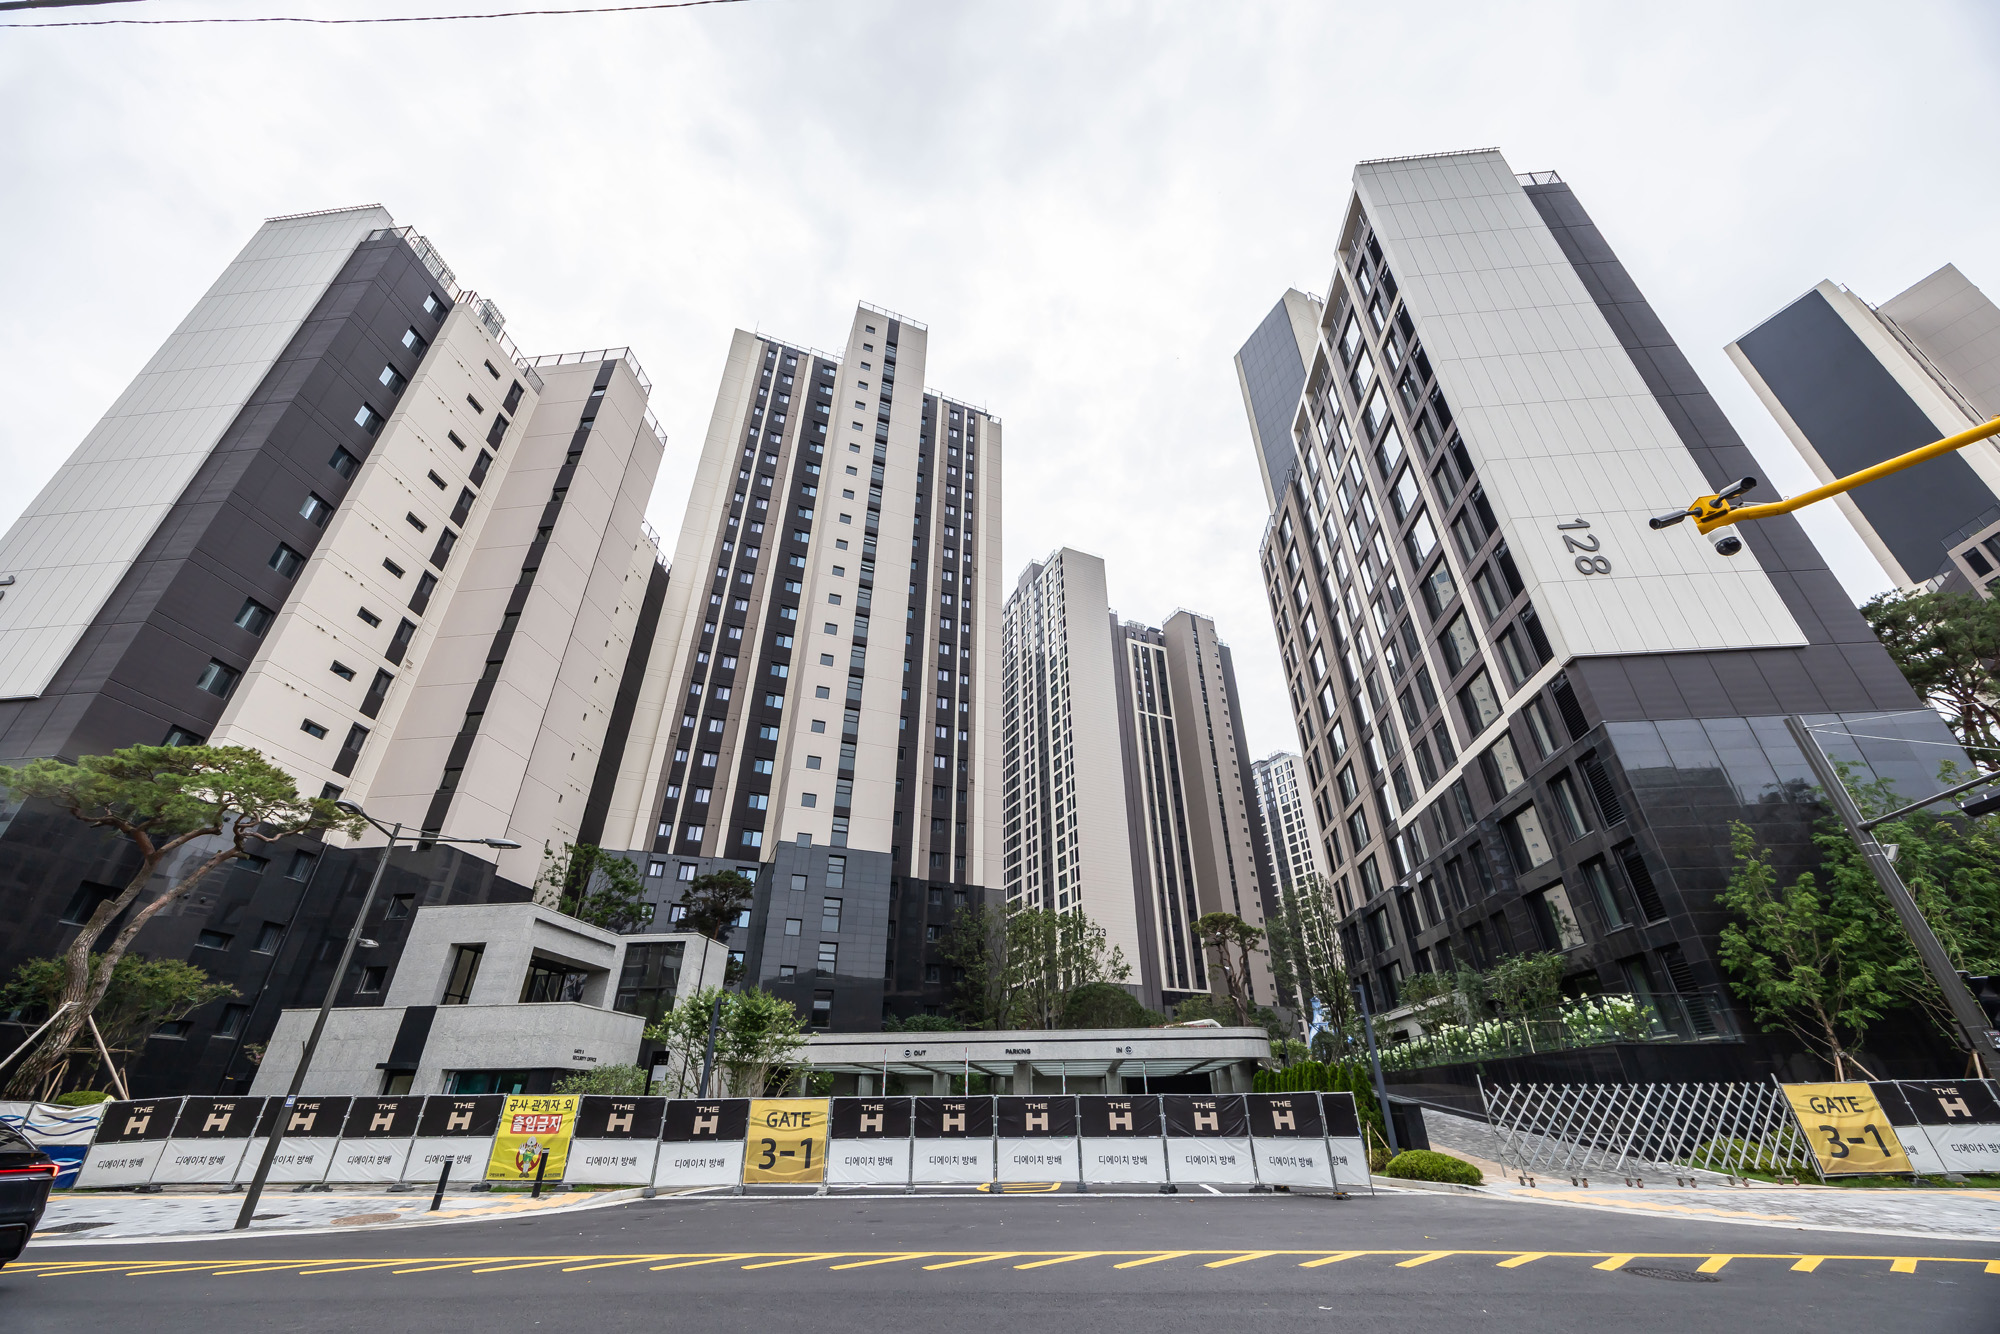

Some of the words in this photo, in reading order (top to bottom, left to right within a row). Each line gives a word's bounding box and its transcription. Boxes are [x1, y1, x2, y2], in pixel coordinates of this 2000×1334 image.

[1557, 518, 1612, 575] 128
[509, 1099, 528, 1112] 공사
[531, 1099, 561, 1112] 관계자
[564, 1099, 574, 1112] 외
[612, 1103, 636, 1111] THE
[1810, 1096, 1864, 1114] GATE
[1938, 1097, 1973, 1117] H
[123, 1115, 151, 1135] H
[202, 1113, 231, 1131] H
[287, 1112, 317, 1131] H
[369, 1112, 395, 1131] H
[446, 1112, 473, 1130] H
[512, 1114, 562, 1132] 출입금지
[606, 1113, 634, 1132] H
[693, 1115, 719, 1134] H
[767, 1112, 811, 1128] GATE
[860, 1113, 884, 1132] H
[942, 1113, 966, 1131] H
[1025, 1112, 1049, 1131] H
[1109, 1111, 1133, 1130] H
[1194, 1111, 1219, 1130] H
[1272, 1110, 1296, 1130] H
[1819, 1124, 1891, 1158] 3-1
[1950, 1143, 1988, 1154] 디에이치
[1988, 1143, 2000, 1154] 방
[97, 1159, 128, 1169] 디에이치
[129, 1157, 145, 1168] 방배
[175, 1156, 207, 1166] 디에이치
[208, 1155, 225, 1166] 방배
[273, 1154, 295, 1165] 에이치
[297, 1154, 315, 1165] 방배
[347, 1156, 376, 1165] 디에이치
[377, 1155, 393, 1165] 방배
[425, 1154, 447, 1165] 디에이
[456, 1154, 473, 1165] 방배
[585, 1156, 618, 1167] 디에이치
[621, 1156, 637, 1167] 방배
[758, 1138, 813, 1170] 3-1
[844, 1156, 875, 1167] 디에이치
[877, 1156, 893, 1167] 방배
[929, 1156, 959, 1166] 디에이치
[961, 1155, 978, 1166] 방배
[1013, 1155, 1044, 1165] 디에이치
[1046, 1155, 1063, 1166] 방배
[1098, 1155, 1130, 1165] 디에이치
[1131, 1155, 1148, 1166] 방배
[1185, 1155, 1218, 1165] 디에이치
[1219, 1155, 1236, 1166] 방배
[1269, 1156, 1297, 1167] 디에이치
[1298, 1157, 1314, 1168] 방배
[674, 1159, 706, 1169] 디에이치
[708, 1158, 725, 1168] 방배
